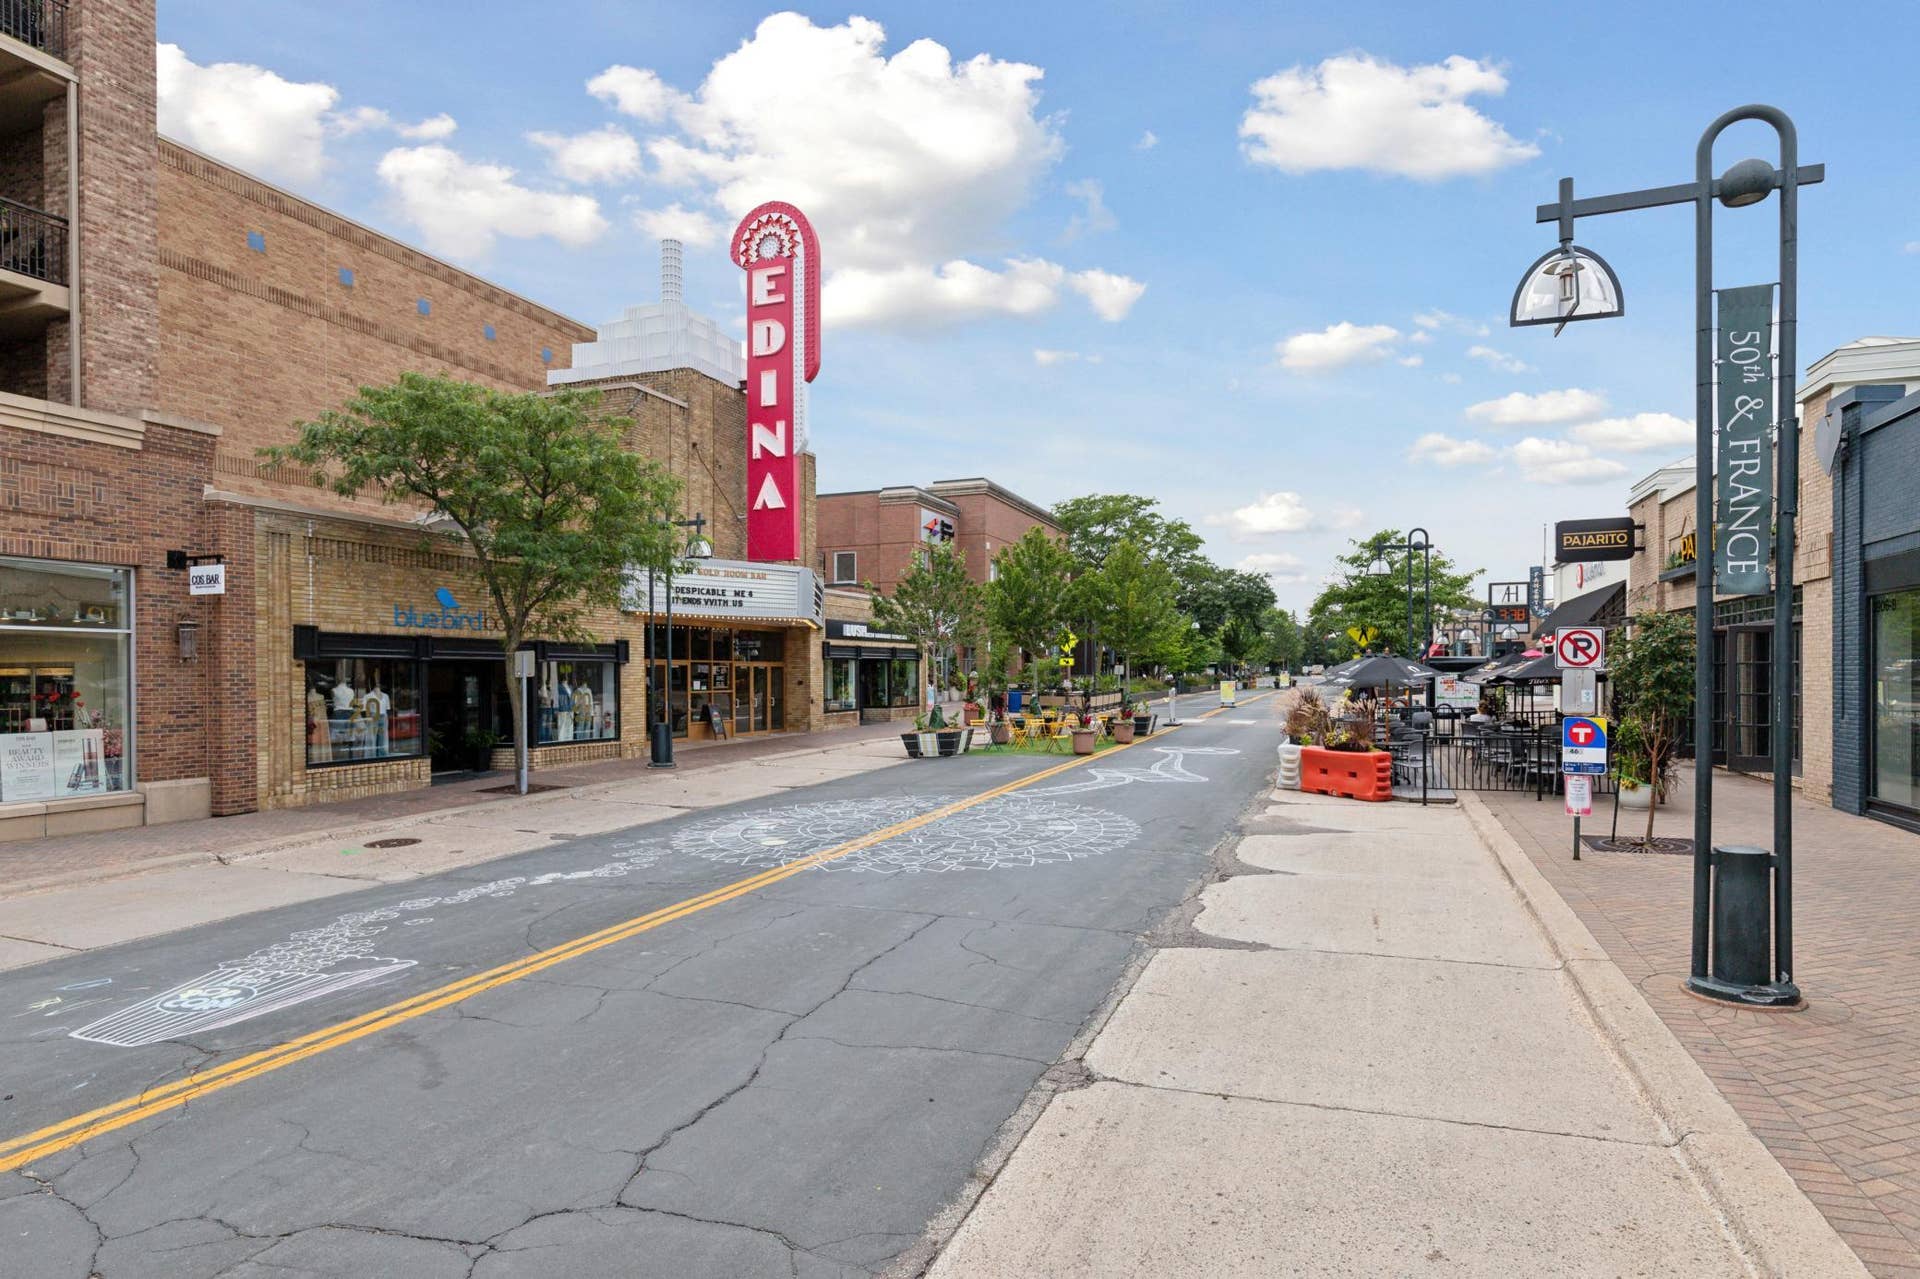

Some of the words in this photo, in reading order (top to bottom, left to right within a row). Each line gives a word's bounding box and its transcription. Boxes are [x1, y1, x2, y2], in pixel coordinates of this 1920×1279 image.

[1729, 331, 1765, 383] 50th
[752, 265, 786, 511] EDINA
[1726, 395, 1764, 431] &
[1726, 438, 1762, 574] FRANCE
[1563, 533, 1628, 546] PAJARITO
[191, 574, 205, 585] COS
[206, 573, 220, 584] BAR
[675, 586, 727, 597] DESPICABLE
[179, 987, 242, 1000] POP
